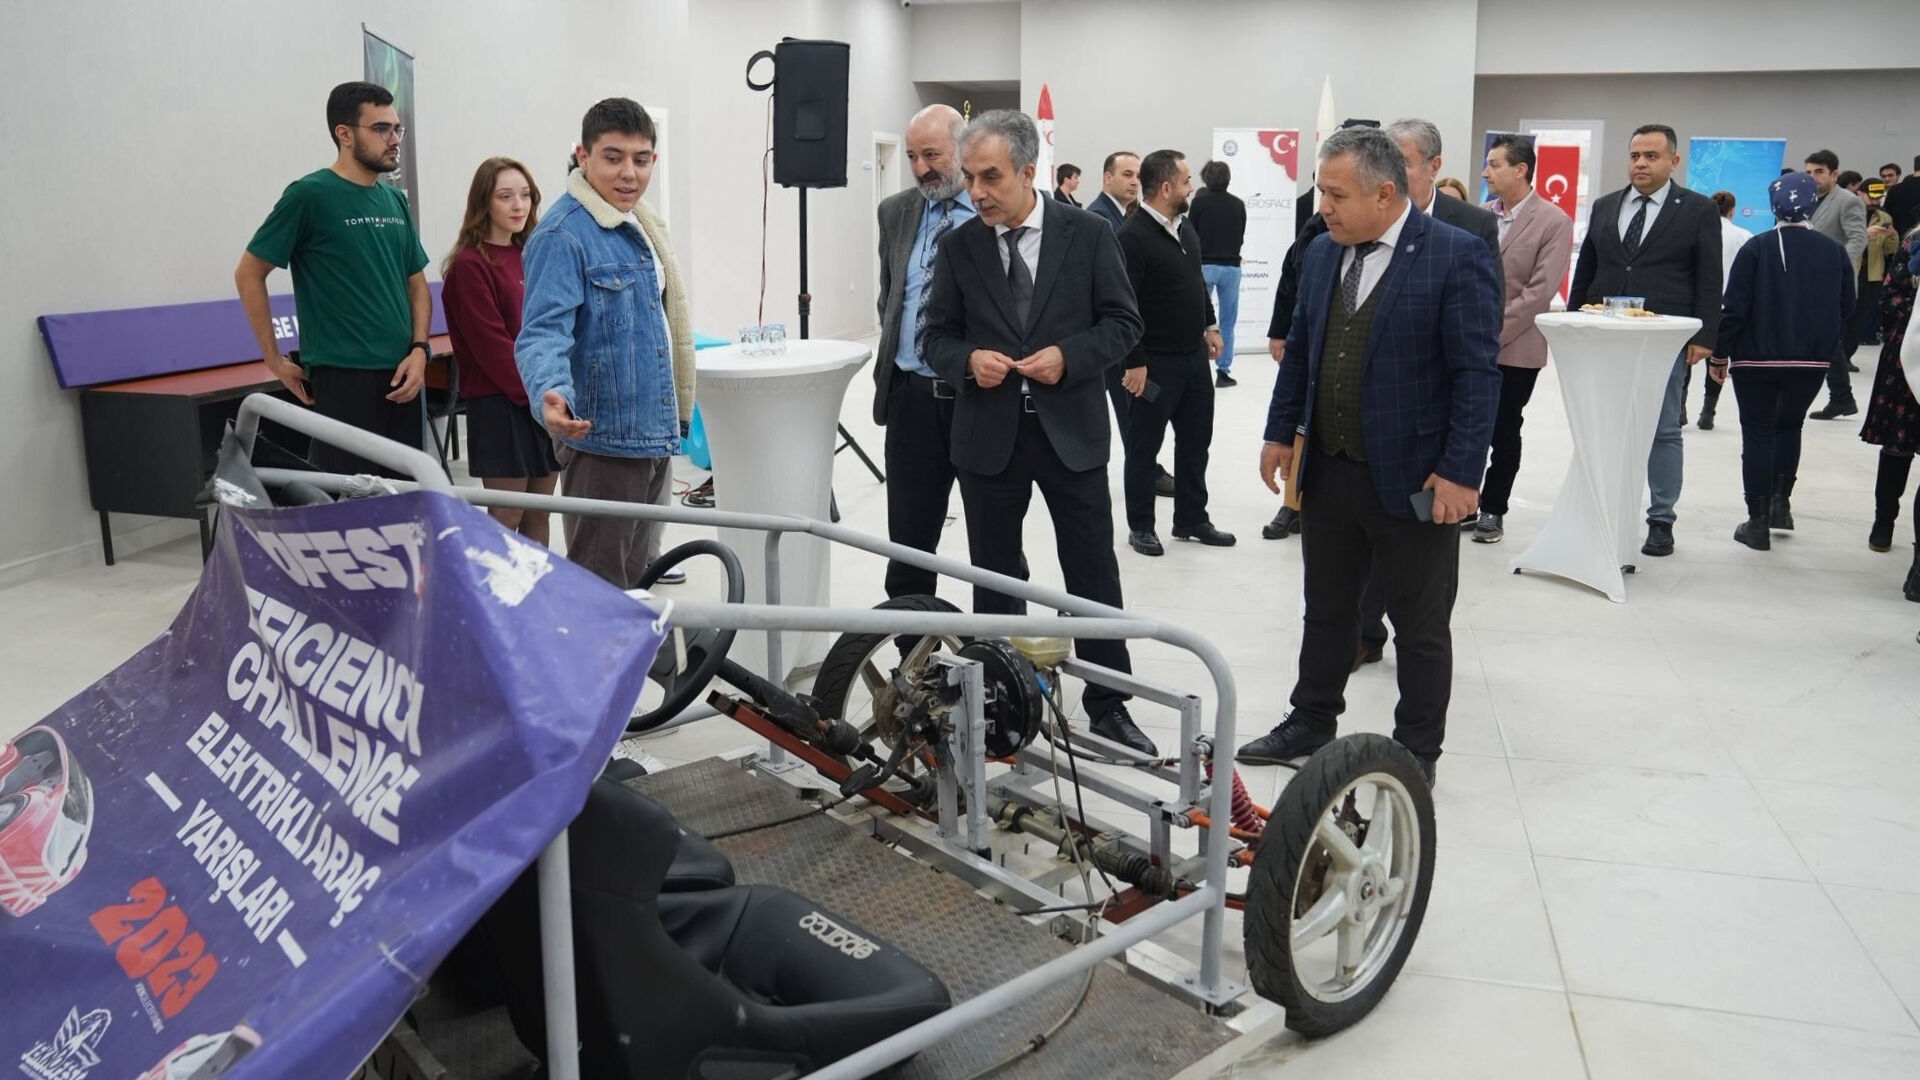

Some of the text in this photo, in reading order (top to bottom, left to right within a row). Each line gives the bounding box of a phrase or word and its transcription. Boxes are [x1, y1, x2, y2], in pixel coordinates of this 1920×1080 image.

[345, 217, 376, 226] TOMMY
[227, 641, 421, 846] CHALLENGE
[175, 798, 295, 945] YARIŞLARI
[302, 823, 382, 928] ARAÇ
[88, 876, 219, 1020] 2023
[798, 911, 881, 960] sparco
